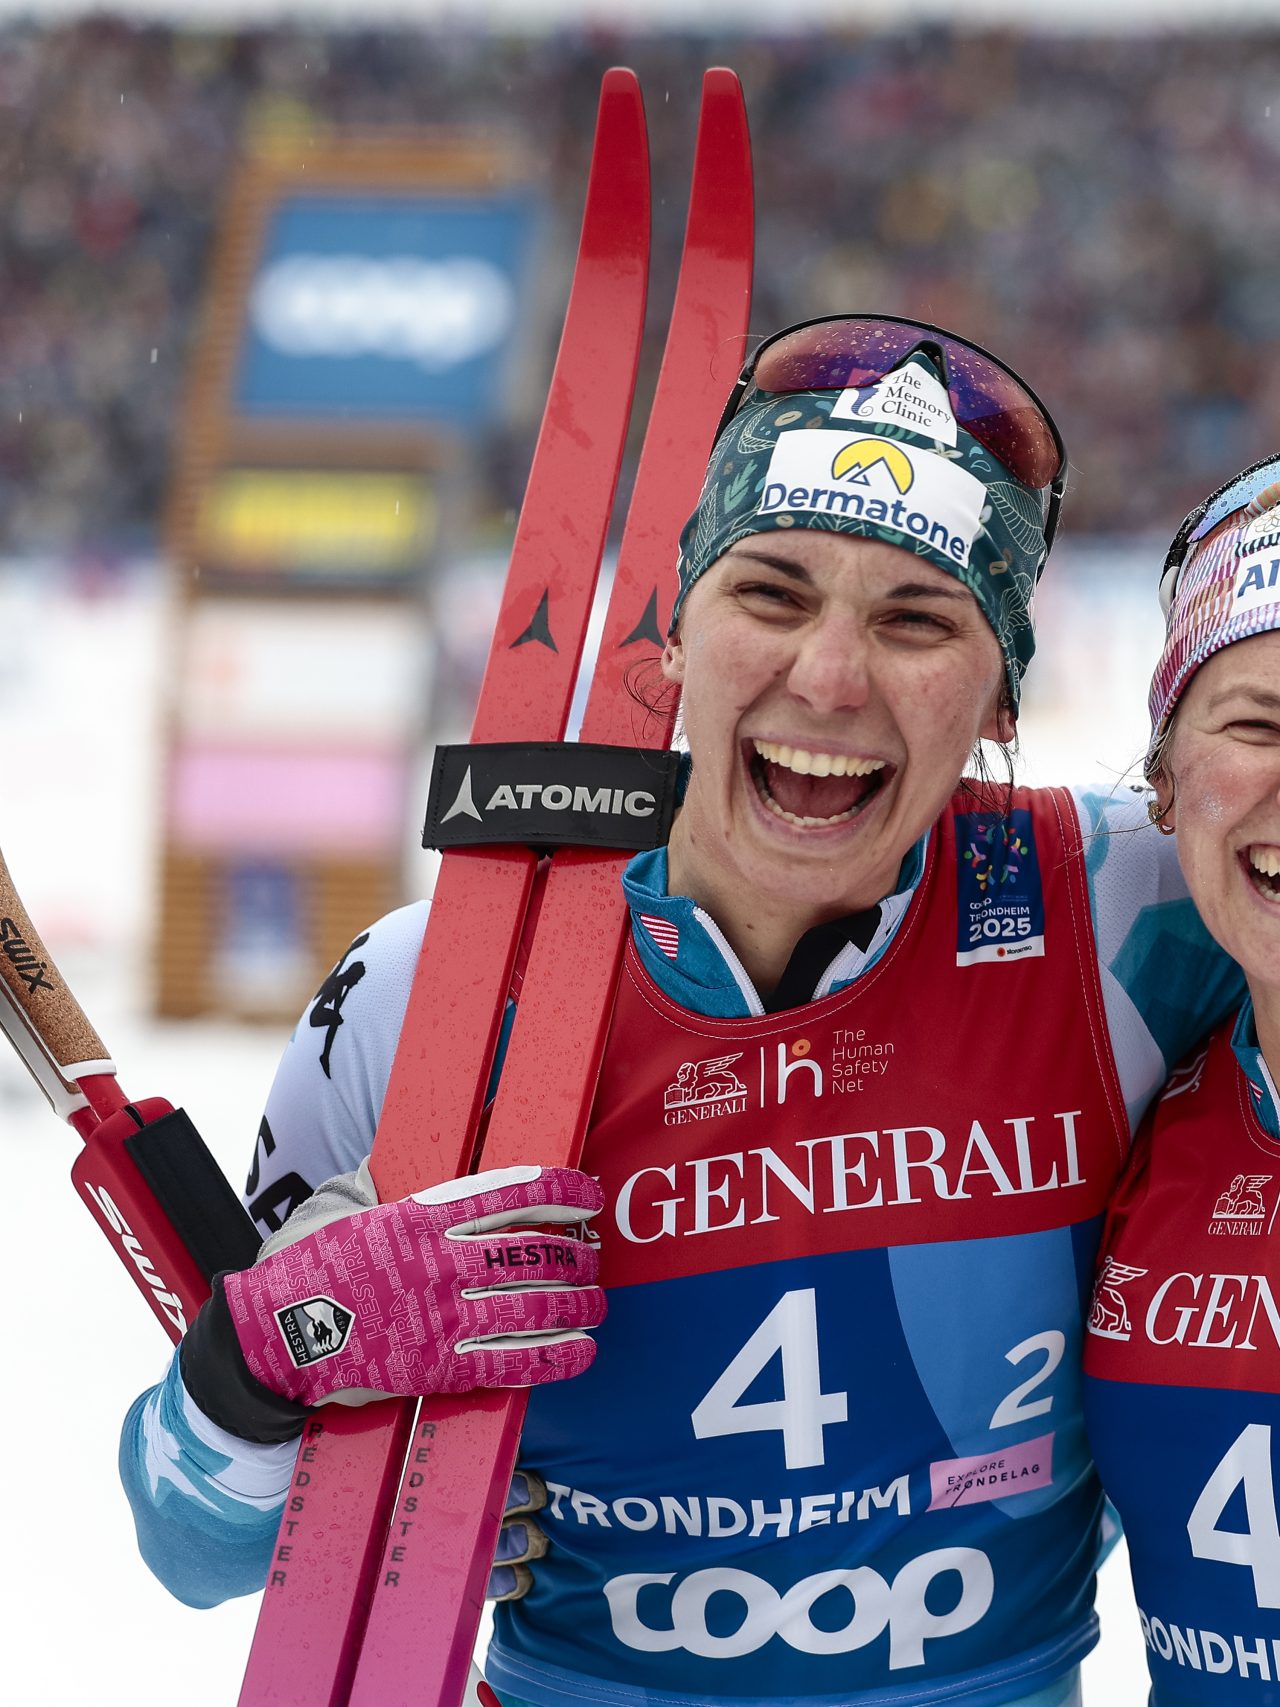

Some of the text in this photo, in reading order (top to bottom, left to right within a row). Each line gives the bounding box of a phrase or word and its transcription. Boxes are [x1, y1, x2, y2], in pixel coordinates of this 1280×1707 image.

[893, 370, 922, 391] The
[881, 399, 932, 428] Clinic
[885, 386, 952, 424] Memory
[762, 482, 970, 562] Dermatone
[485, 784, 656, 817] ATOMIC
[969, 906, 1030, 922] TRONDHEIM
[969, 917, 1032, 942] 2025
[831, 1029, 867, 1045] The
[831, 1040, 896, 1062] Human
[831, 1058, 890, 1078] Safety
[831, 1077, 865, 1095] Net
[664, 1097, 748, 1127] GENERALI
[614, 1110, 1087, 1244] GENERALI
[1207, 1220, 1265, 1237] GENERALI
[485, 1243, 577, 1269] HESTRA
[284, 1311, 310, 1364] HESTRA
[691, 1287, 848, 1470] 4
[989, 1329, 1066, 1430] 2
[948, 1459, 1005, 1486] EXPLORE
[270, 1421, 324, 1588] REDSTER
[384, 1422, 437, 1588] REDSTER
[546, 1474, 910, 1538] TRONDHEIM
[602, 1546, 995, 1671] coop
